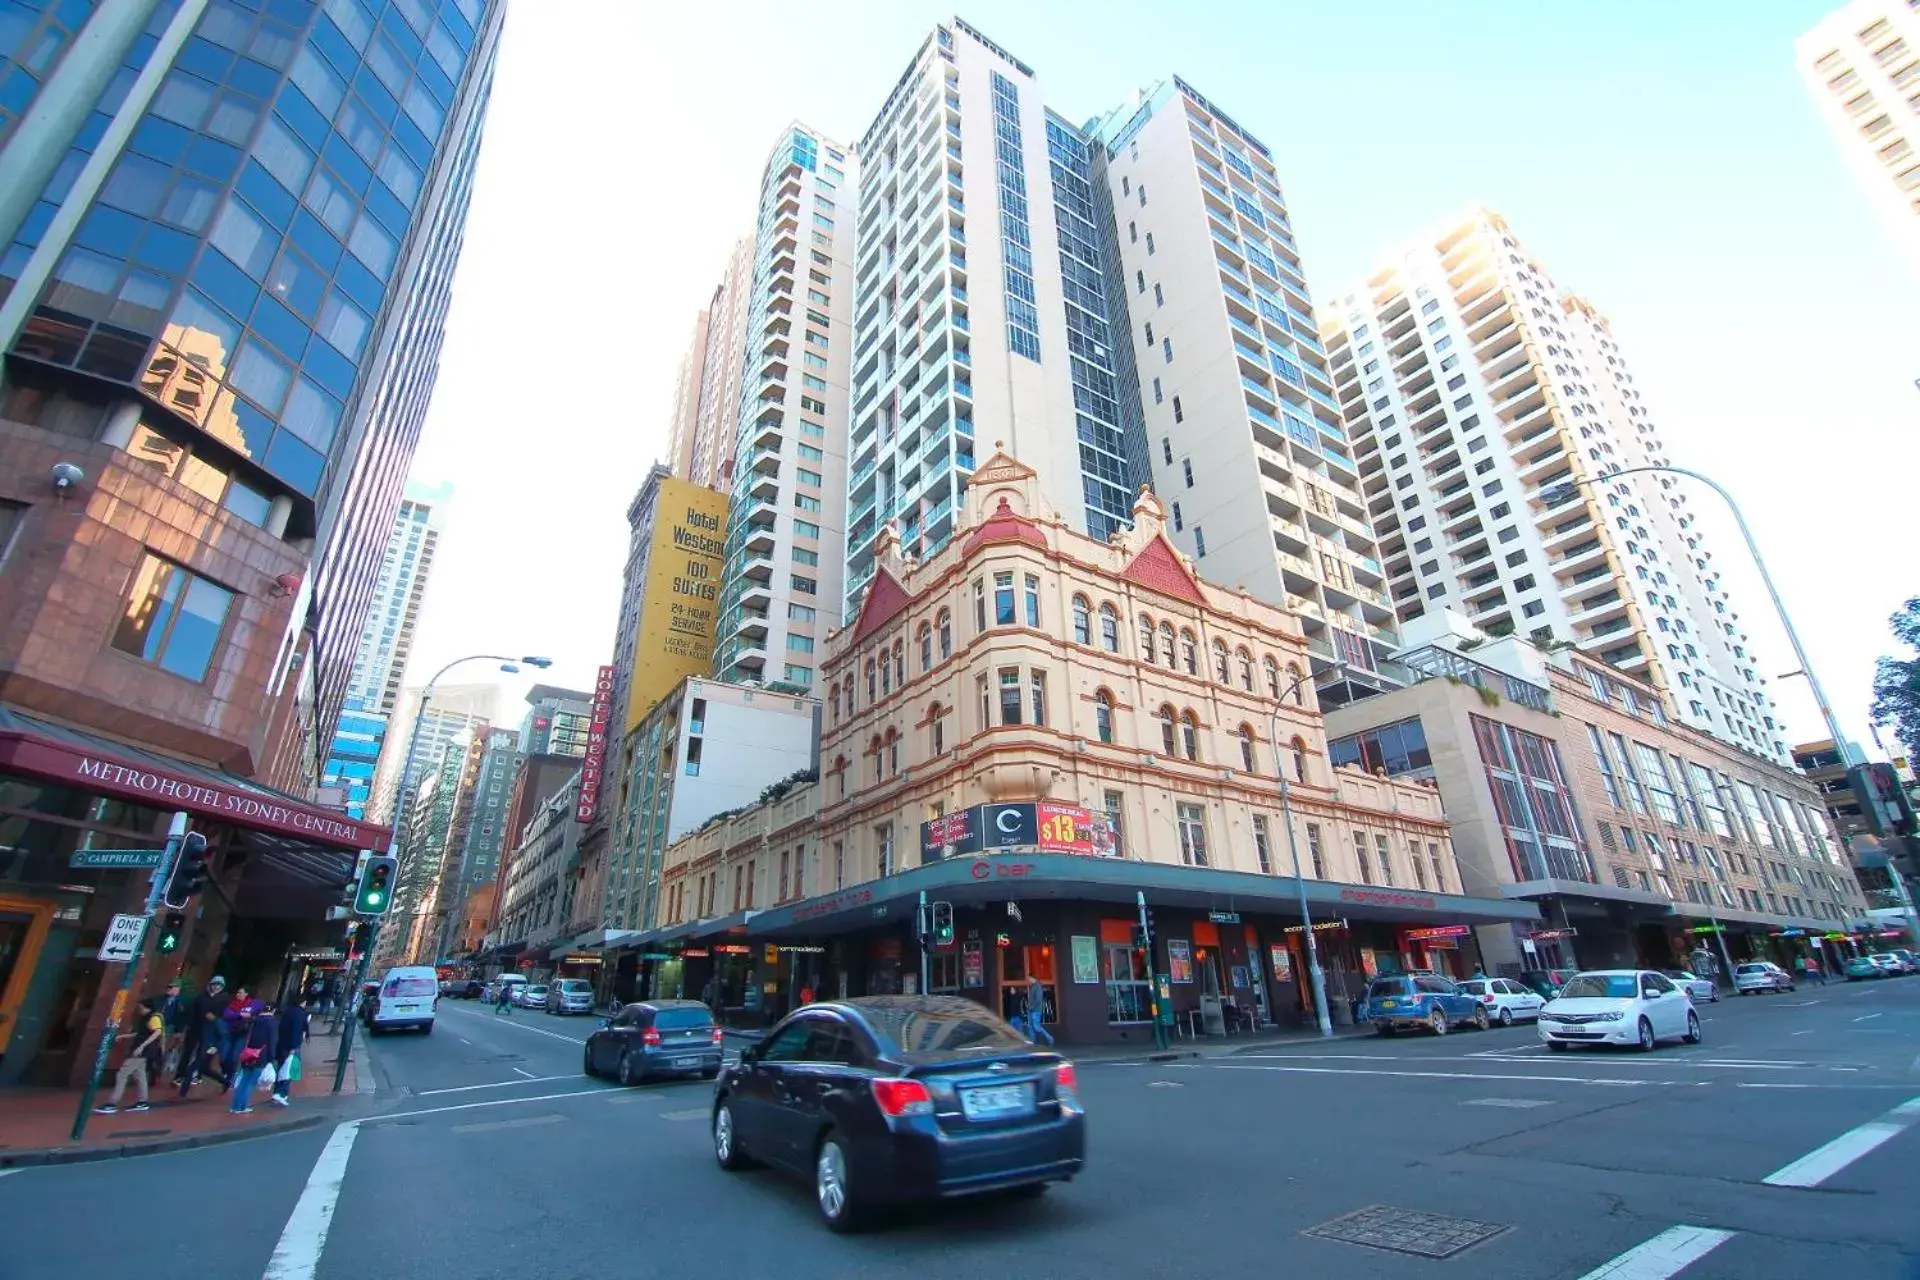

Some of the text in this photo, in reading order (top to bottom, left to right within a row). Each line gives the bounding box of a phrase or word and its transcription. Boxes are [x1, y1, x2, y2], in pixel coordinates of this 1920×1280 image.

[686, 506, 719, 533] Hotel
[686, 559, 708, 579] 100
[672, 576, 716, 601] SUITES
[594, 669, 613, 724] HOTEL
[77, 757, 358, 841] METRO HOTEL SYDNEY CENTRAL
[996, 808, 1023, 833] C
[1042, 815, 1074, 843] $13
[87, 854, 159, 863] CAMPBELL ST
[972, 861, 1036, 879] C bar
[117, 918, 141, 931] ONE
[111, 933, 136, 943] WAY
